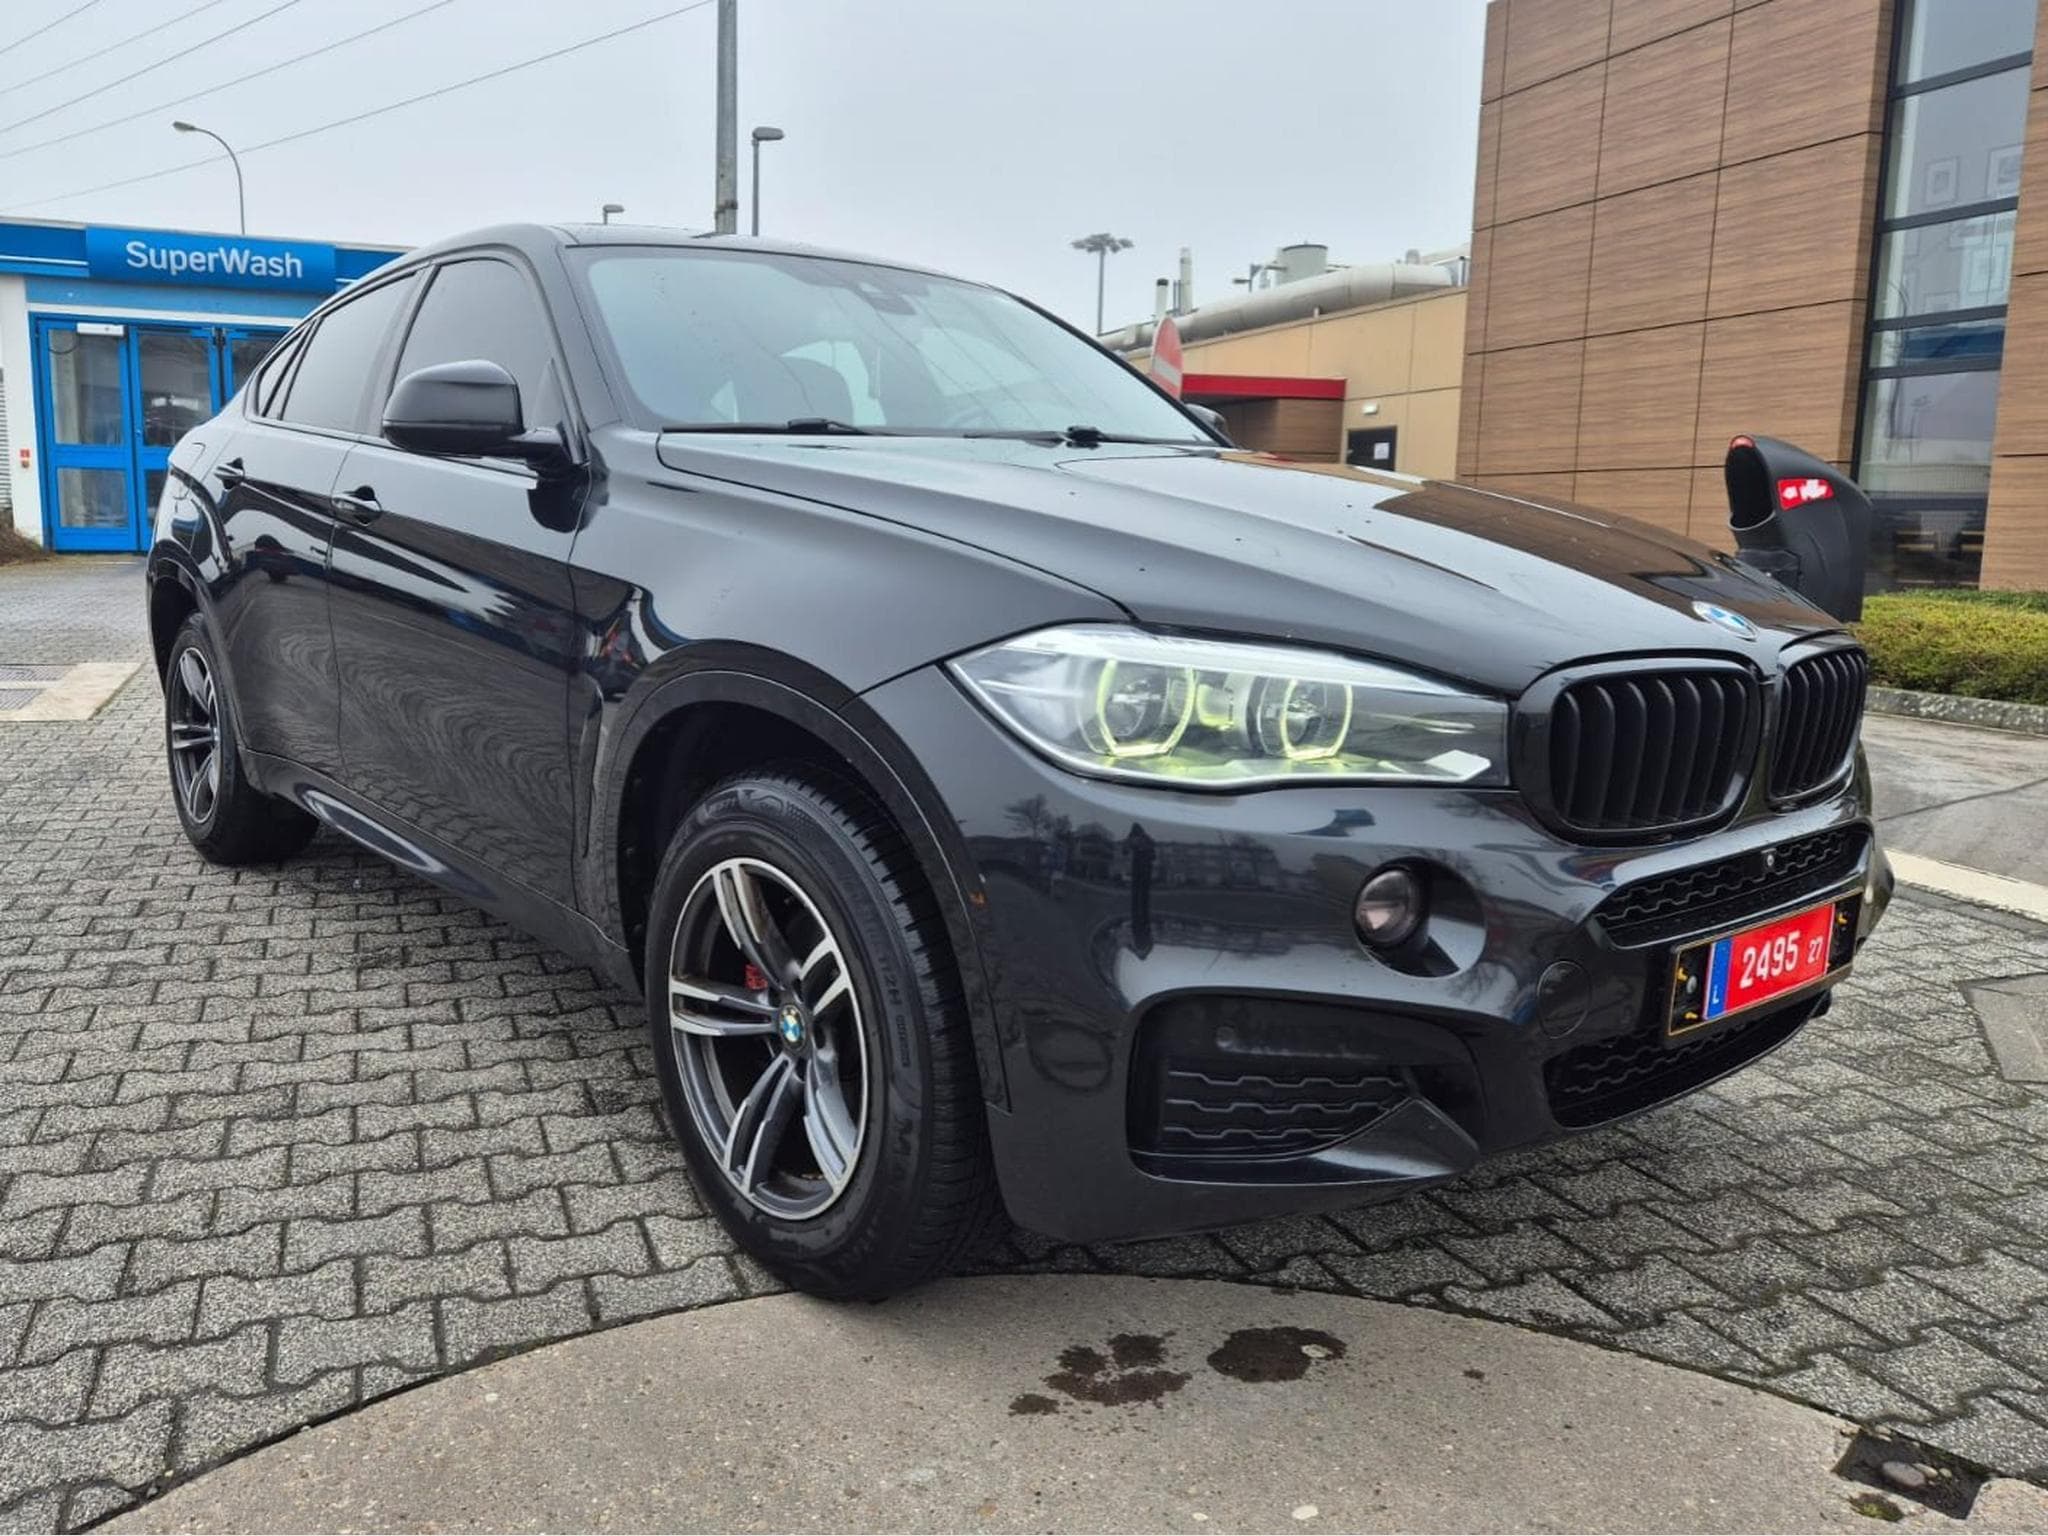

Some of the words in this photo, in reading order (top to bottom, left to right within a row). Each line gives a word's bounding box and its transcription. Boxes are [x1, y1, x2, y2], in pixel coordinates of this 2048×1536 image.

[126, 241, 302, 279] SuperWash
[1740, 930, 1801, 989] 2495
[1808, 936, 1823, 964] 27
[1712, 984, 1720, 1005] L
